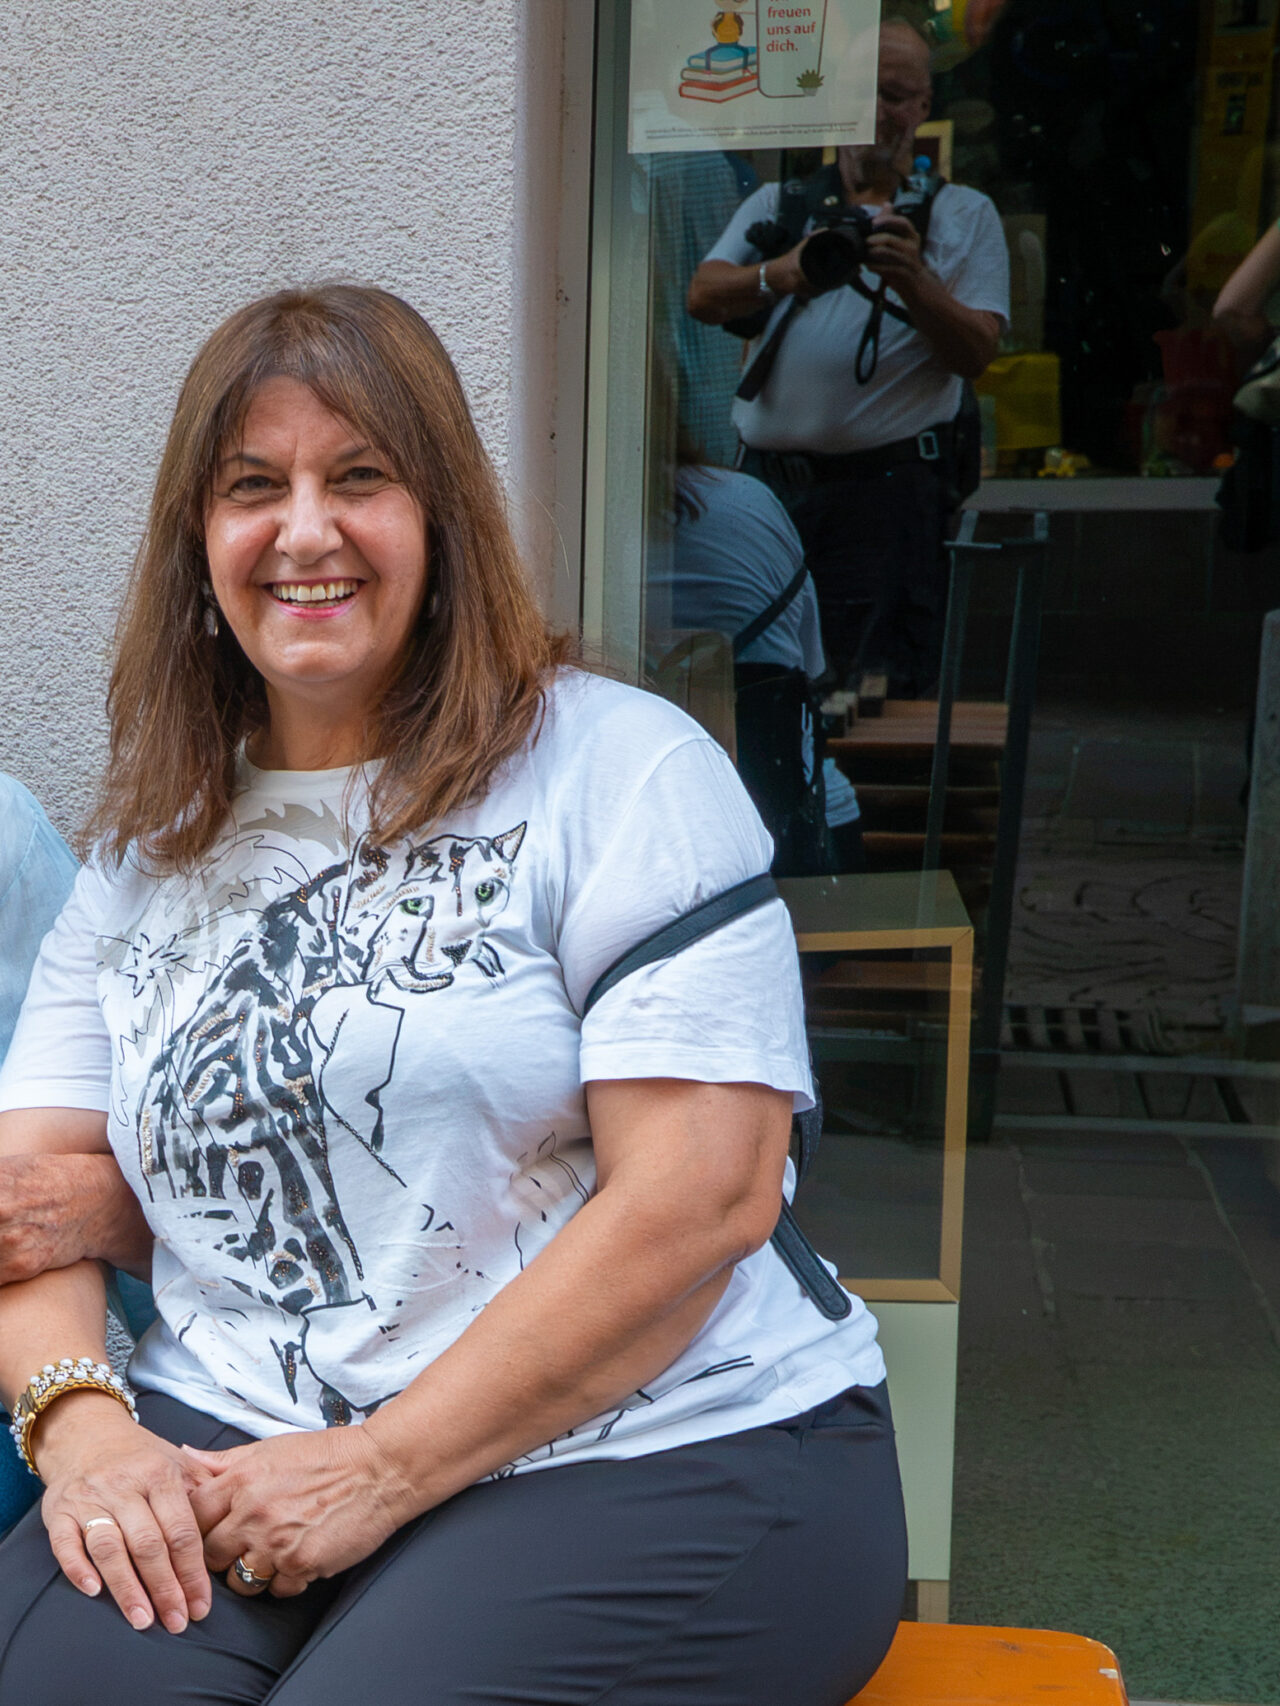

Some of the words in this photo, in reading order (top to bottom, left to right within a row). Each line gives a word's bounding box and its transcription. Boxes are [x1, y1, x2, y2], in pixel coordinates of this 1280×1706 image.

[767, 6, 811, 18] freuen
[767, 25, 791, 35] uns
[794, 21, 816, 34] auf
[766, 38, 799, 52] dich.
